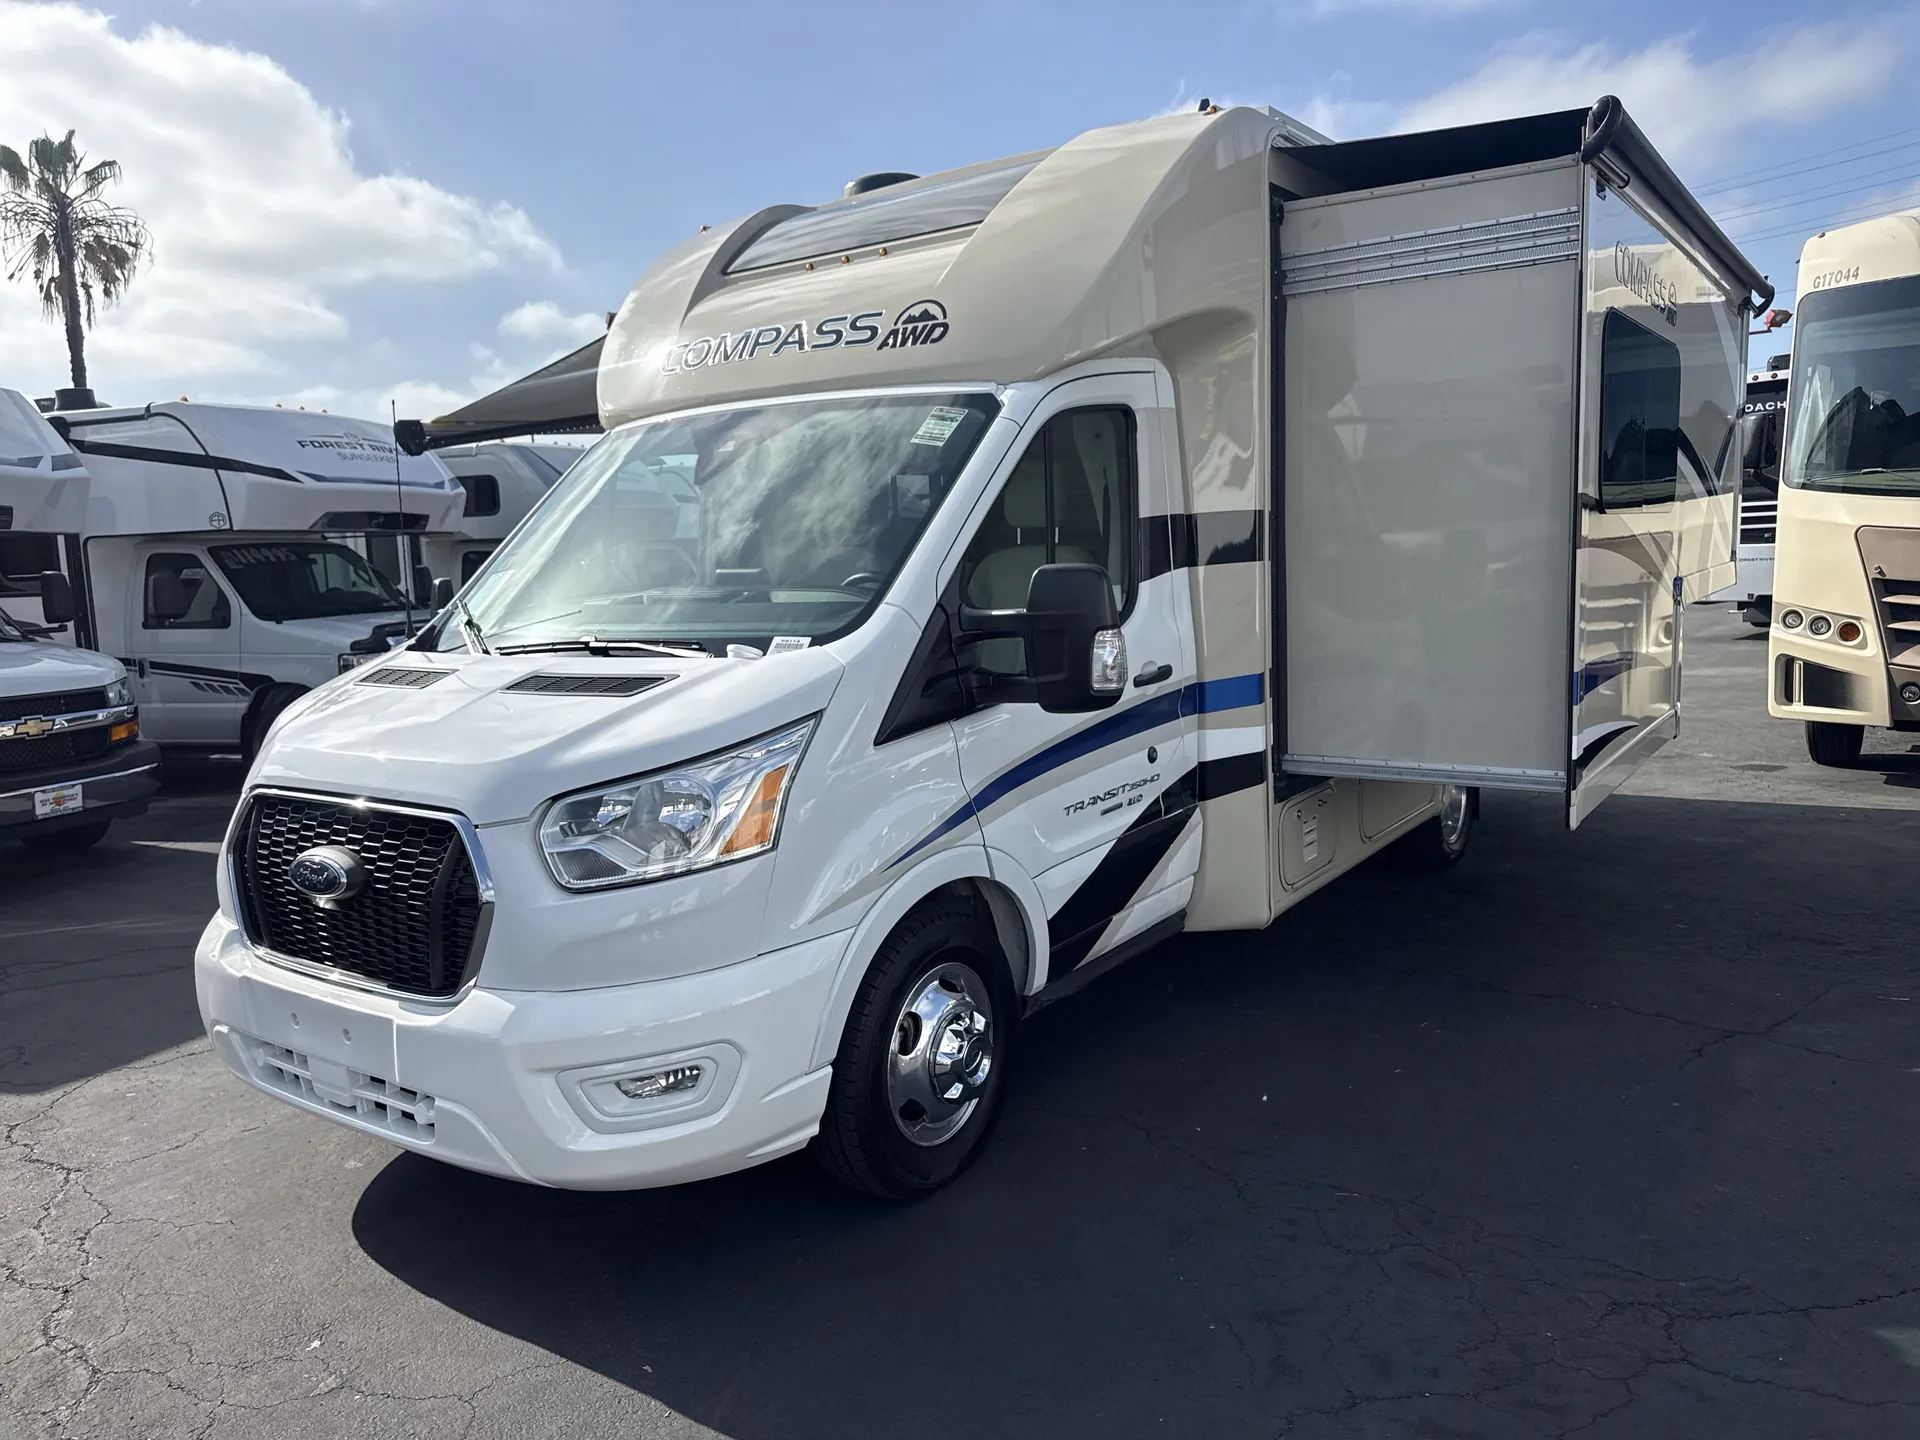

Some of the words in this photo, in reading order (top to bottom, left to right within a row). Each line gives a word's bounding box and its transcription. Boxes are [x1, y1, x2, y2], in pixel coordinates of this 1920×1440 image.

[1614, 240, 1667, 316] COMPASS
[1812, 265, 1860, 289] G17044
[660, 309, 886, 377] COMPASS
[876, 321, 950, 352] AWD
[296, 439, 367, 452] FOREST
[1063, 782, 1129, 816] TRANSIT
